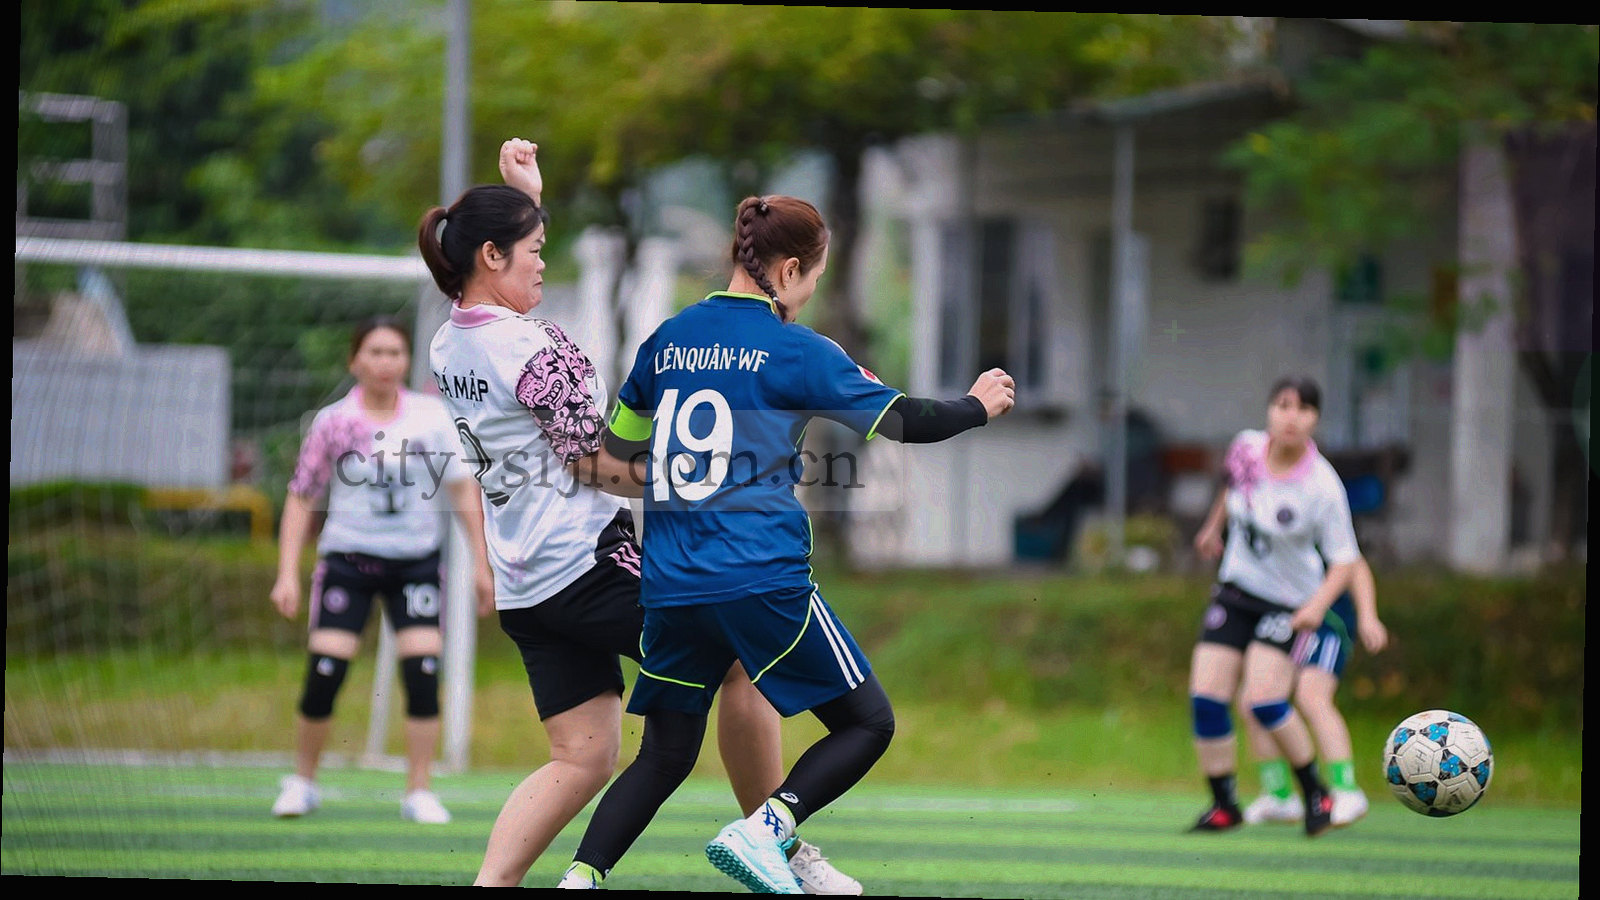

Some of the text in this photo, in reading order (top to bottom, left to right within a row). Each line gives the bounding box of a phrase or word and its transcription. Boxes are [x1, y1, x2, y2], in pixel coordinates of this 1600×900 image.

[654, 342, 770, 375] LIÊNQUÂN-WF
[652, 388, 734, 502] 19
[402, 583, 440, 618] 10
